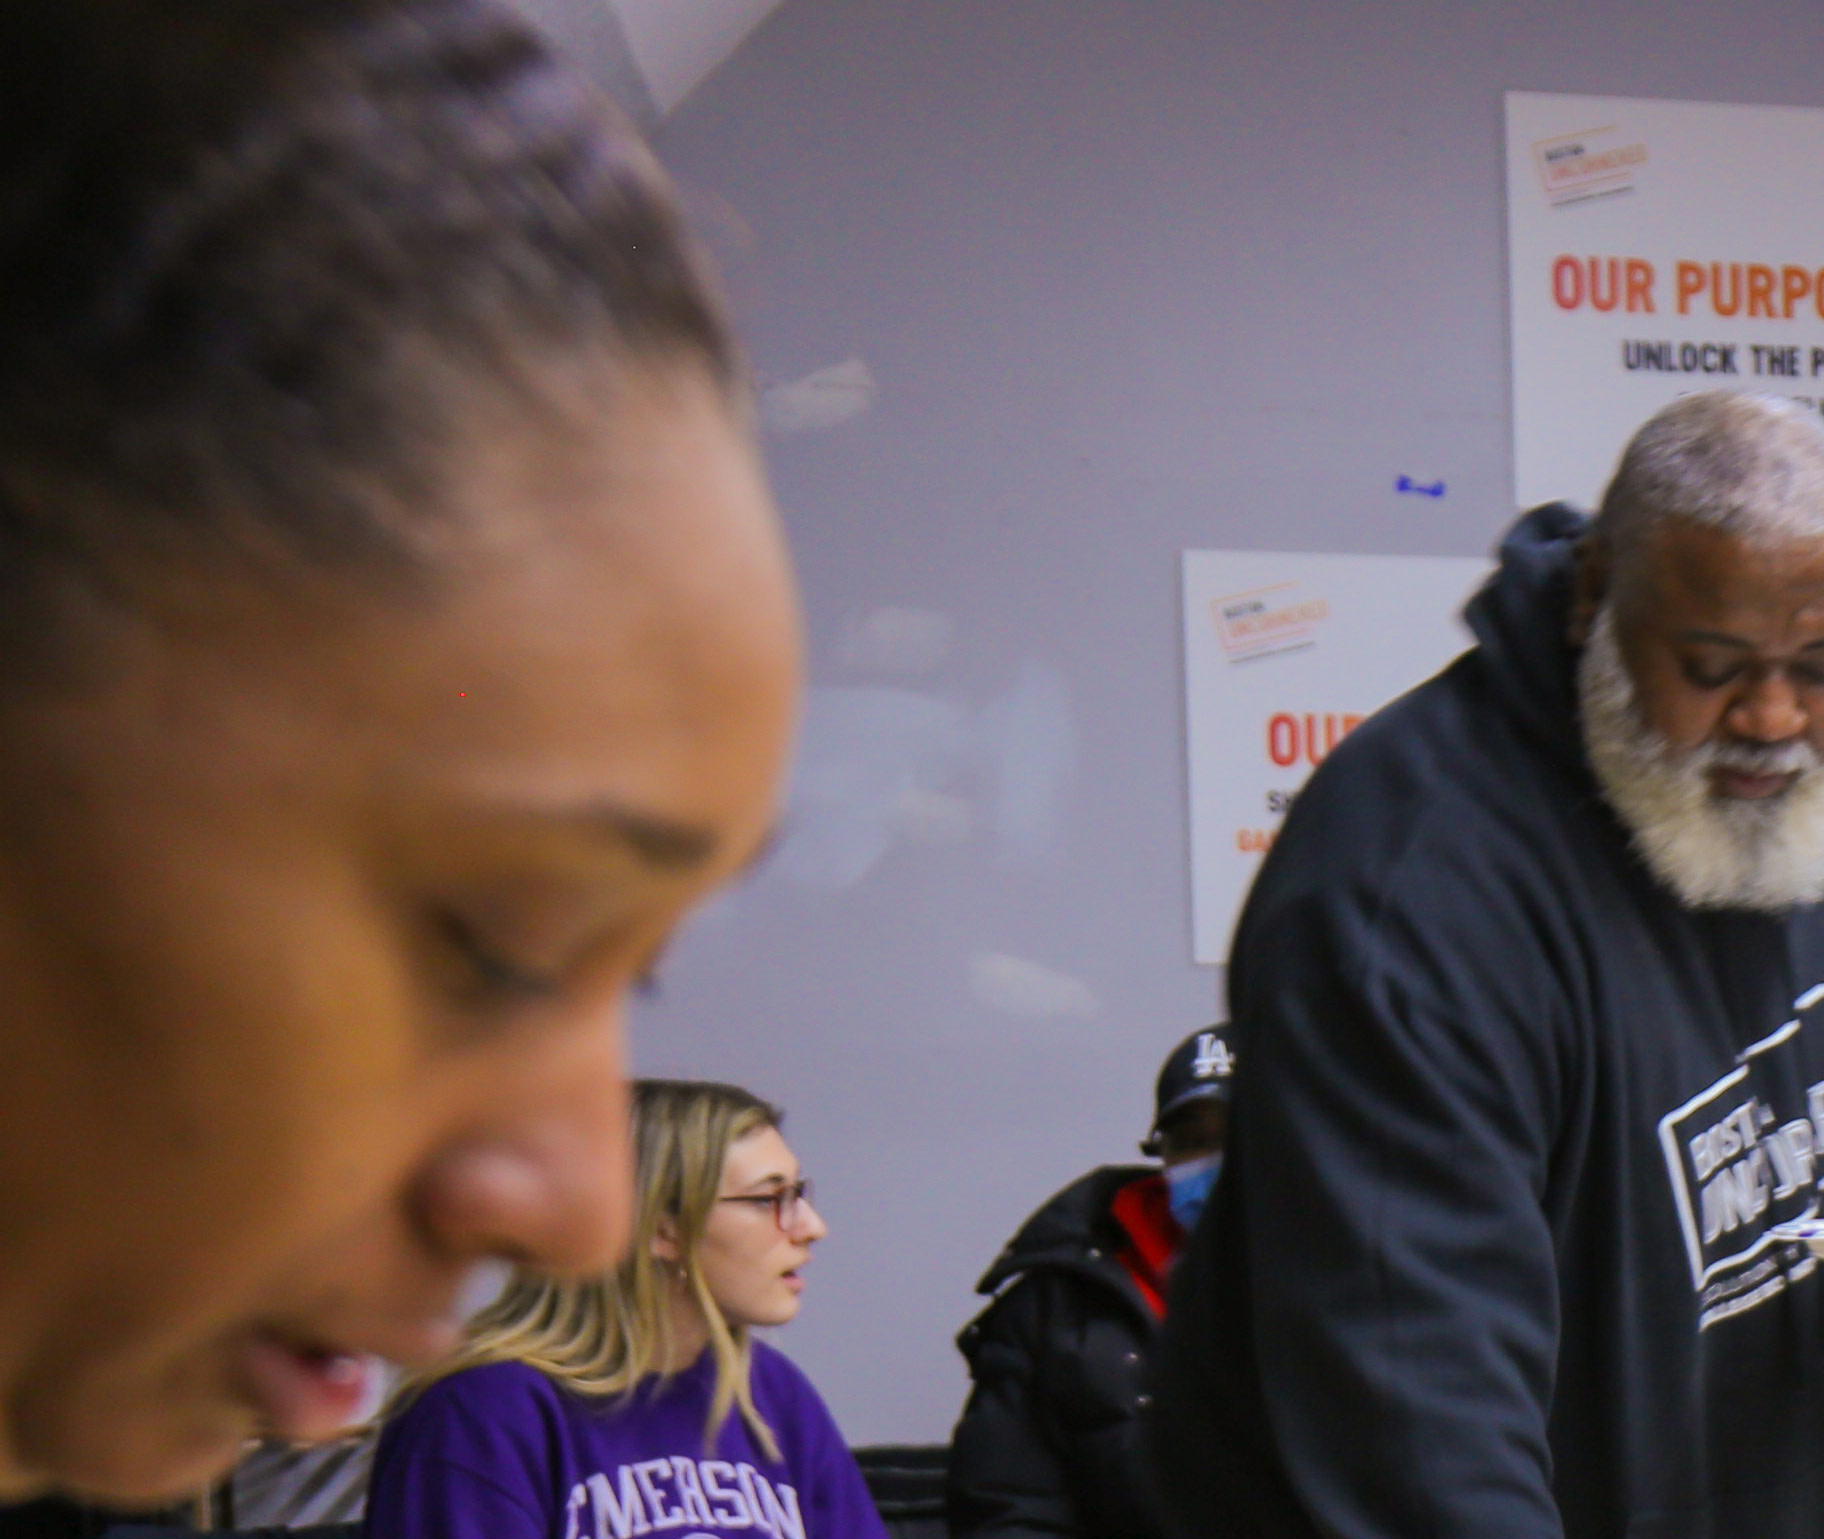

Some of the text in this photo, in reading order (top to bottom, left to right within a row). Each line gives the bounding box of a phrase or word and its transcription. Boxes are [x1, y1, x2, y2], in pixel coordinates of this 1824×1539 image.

[1551, 255, 1656, 314] OUR
[1623, 340, 1737, 375] UNLOCK
[1750, 345, 1800, 377] THE
[1192, 1032, 1235, 1078] LA
